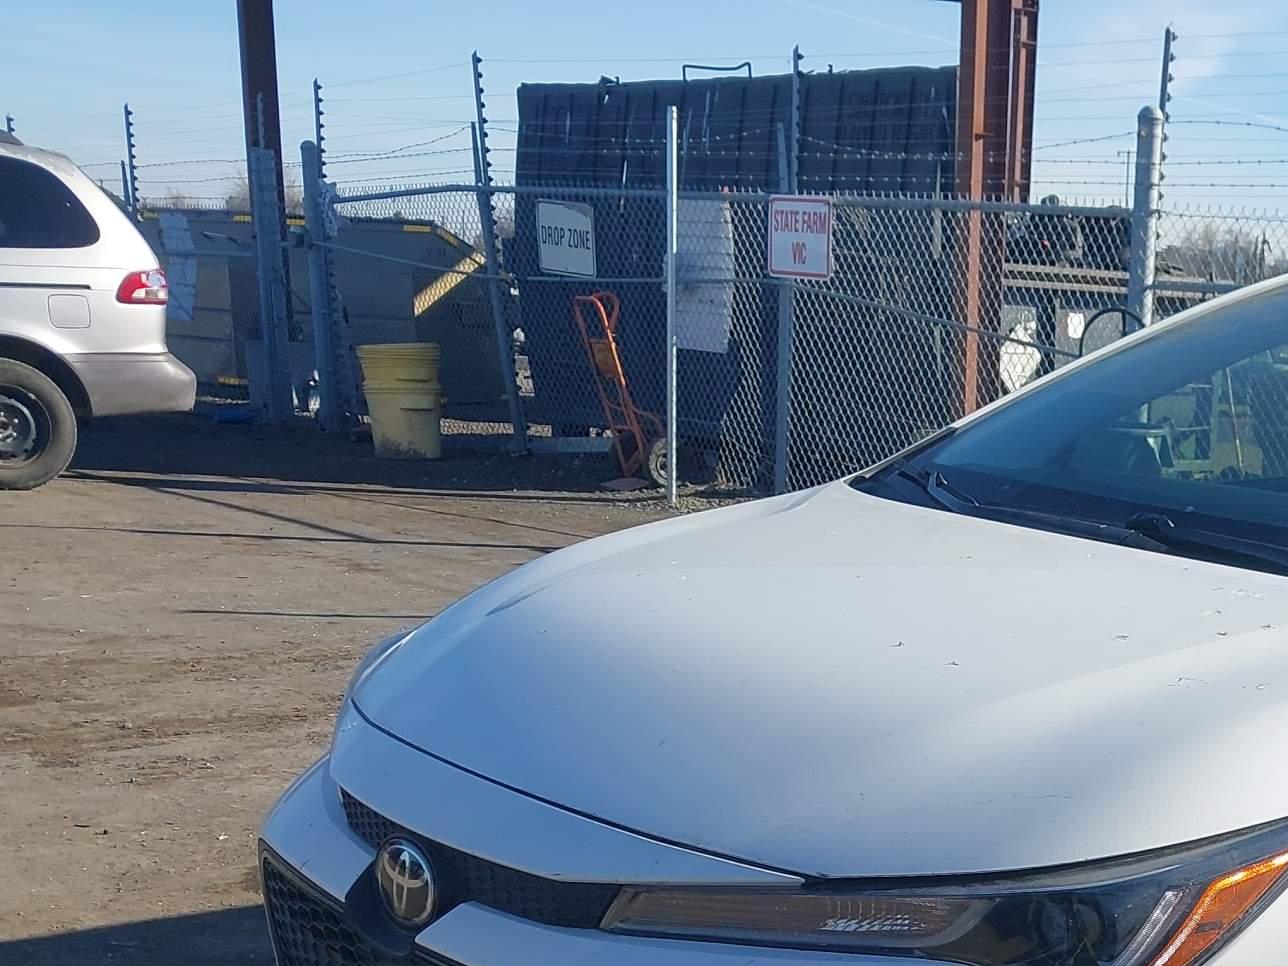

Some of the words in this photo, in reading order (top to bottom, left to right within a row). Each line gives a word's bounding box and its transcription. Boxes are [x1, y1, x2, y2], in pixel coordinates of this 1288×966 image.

[774, 209, 800, 232] STATE
[801, 210, 827, 234] FARM
[541, 224, 565, 246] DROP
[567, 228, 591, 250] ZONE
[791, 241, 807, 265] VIC
